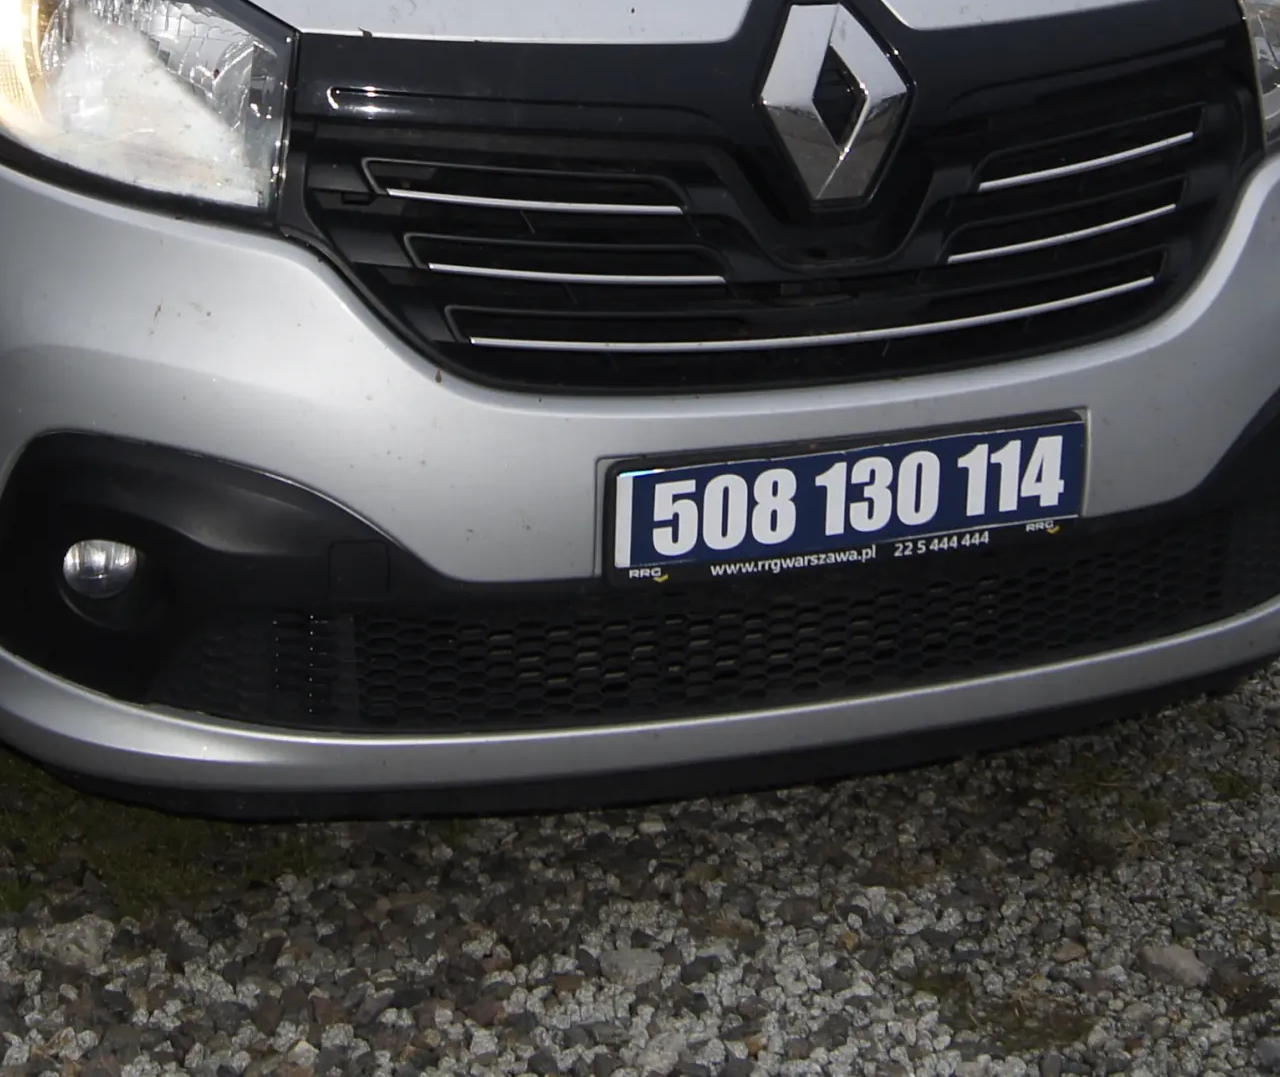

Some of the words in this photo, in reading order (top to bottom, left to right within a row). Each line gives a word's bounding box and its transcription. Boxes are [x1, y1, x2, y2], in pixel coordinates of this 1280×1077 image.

[652, 468, 797, 557] 508
[815, 450, 941, 537] 130
[957, 435, 1065, 517] 114
[629, 566, 662, 579] RRG
[710, 544, 877, 577] www.rrgwarszawa.pl
[893, 542, 913, 558] 22
[916, 540, 927, 554] 5
[929, 535, 958, 552] 444
[961, 530, 990, 547] 444
